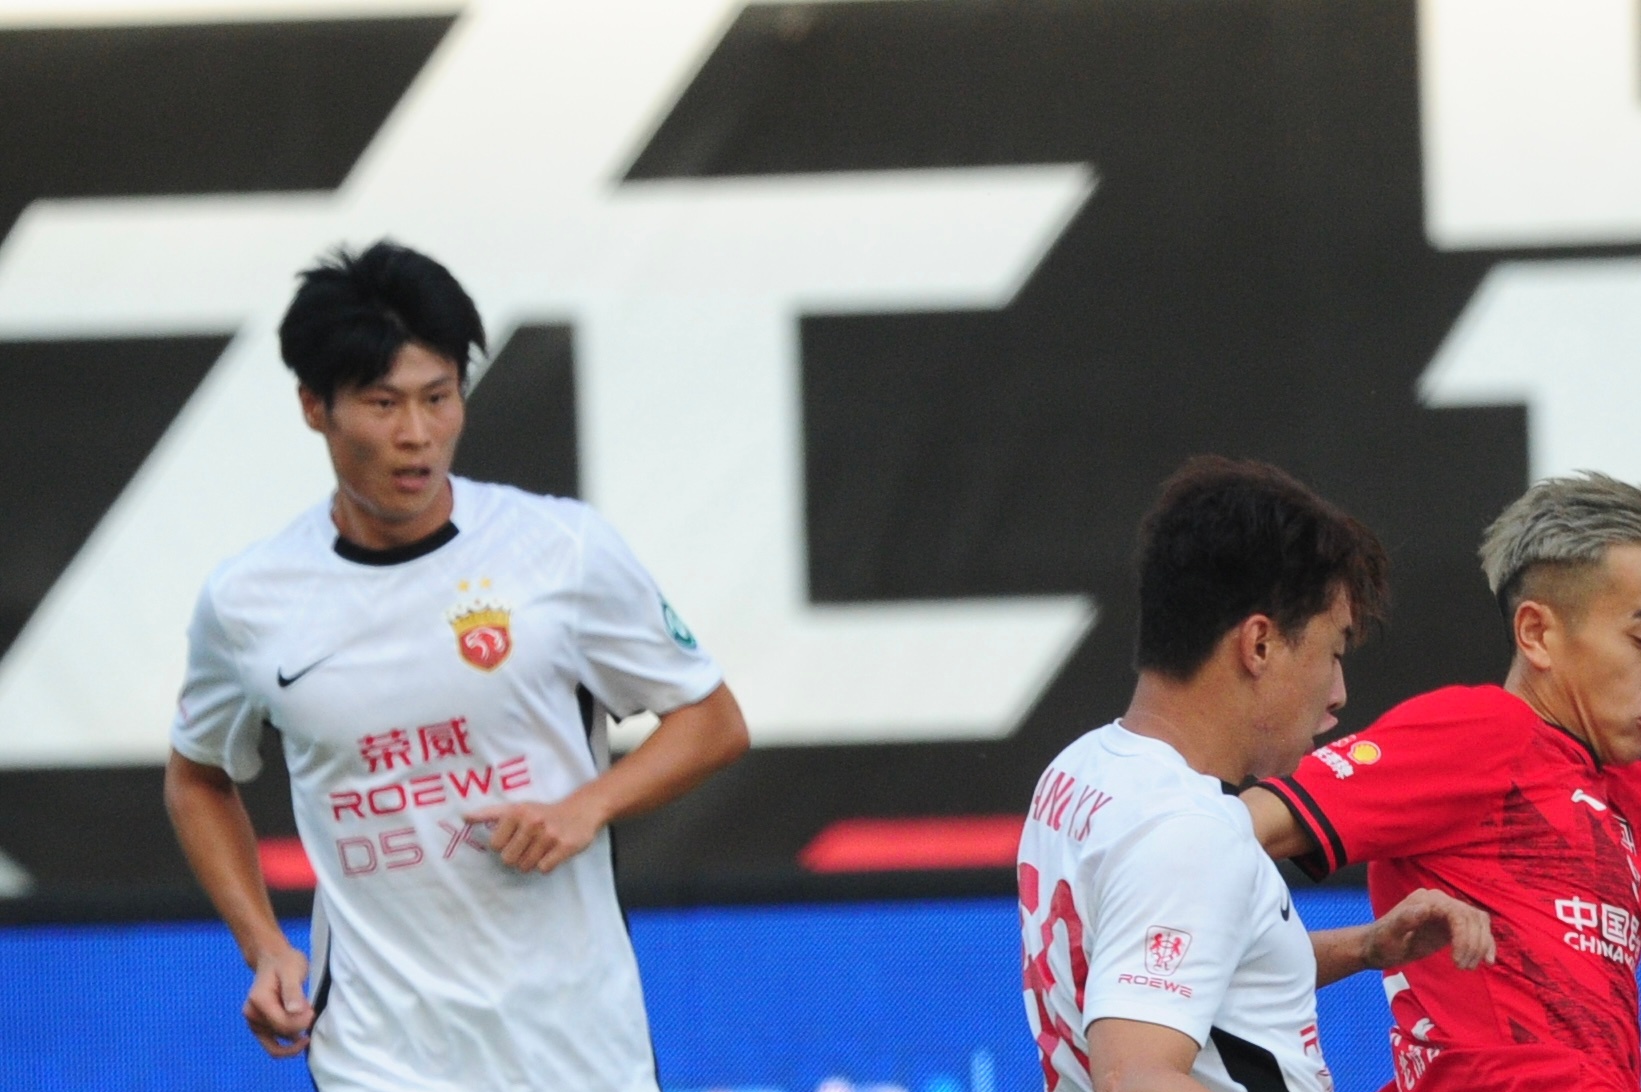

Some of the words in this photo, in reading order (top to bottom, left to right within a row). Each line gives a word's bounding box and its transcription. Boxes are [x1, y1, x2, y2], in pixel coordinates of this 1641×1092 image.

[358, 715, 473, 773] 荣威
[329, 755, 532, 823] ROEWE
[1117, 973, 1194, 999] ROEWE
